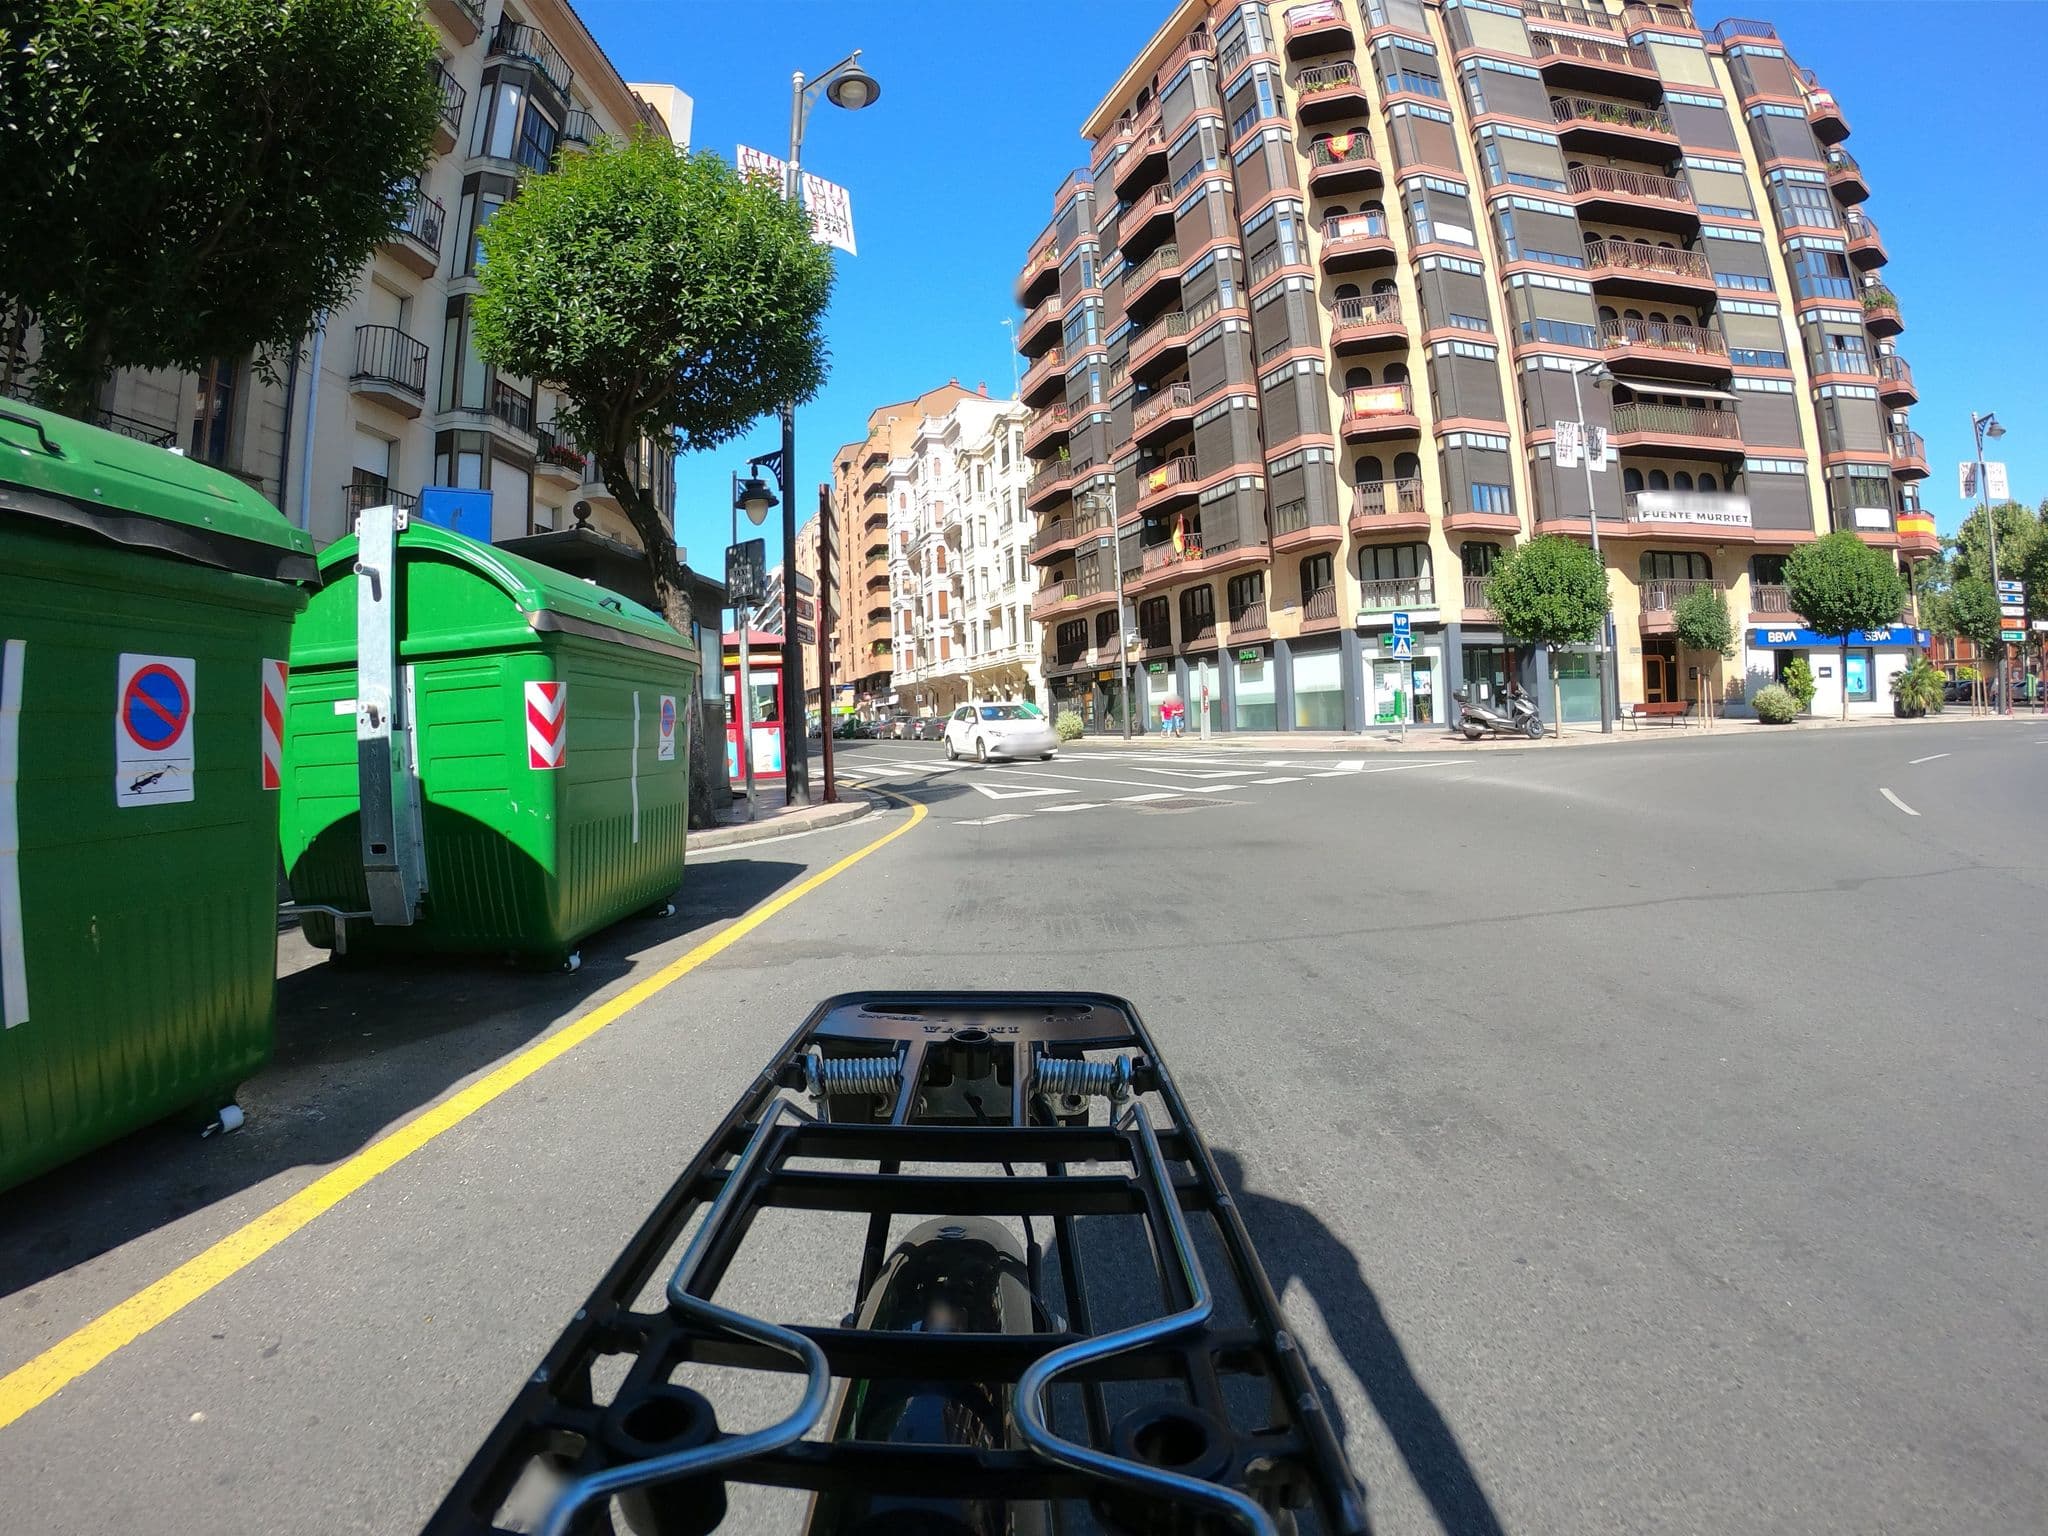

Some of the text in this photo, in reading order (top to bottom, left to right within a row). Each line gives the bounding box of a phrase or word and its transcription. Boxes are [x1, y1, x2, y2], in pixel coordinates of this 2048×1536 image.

[1643, 511, 1751, 523] FUENTE MURRIET
[1396, 616, 1407, 627] VP
[1767, 631, 1797, 643] BBVA
